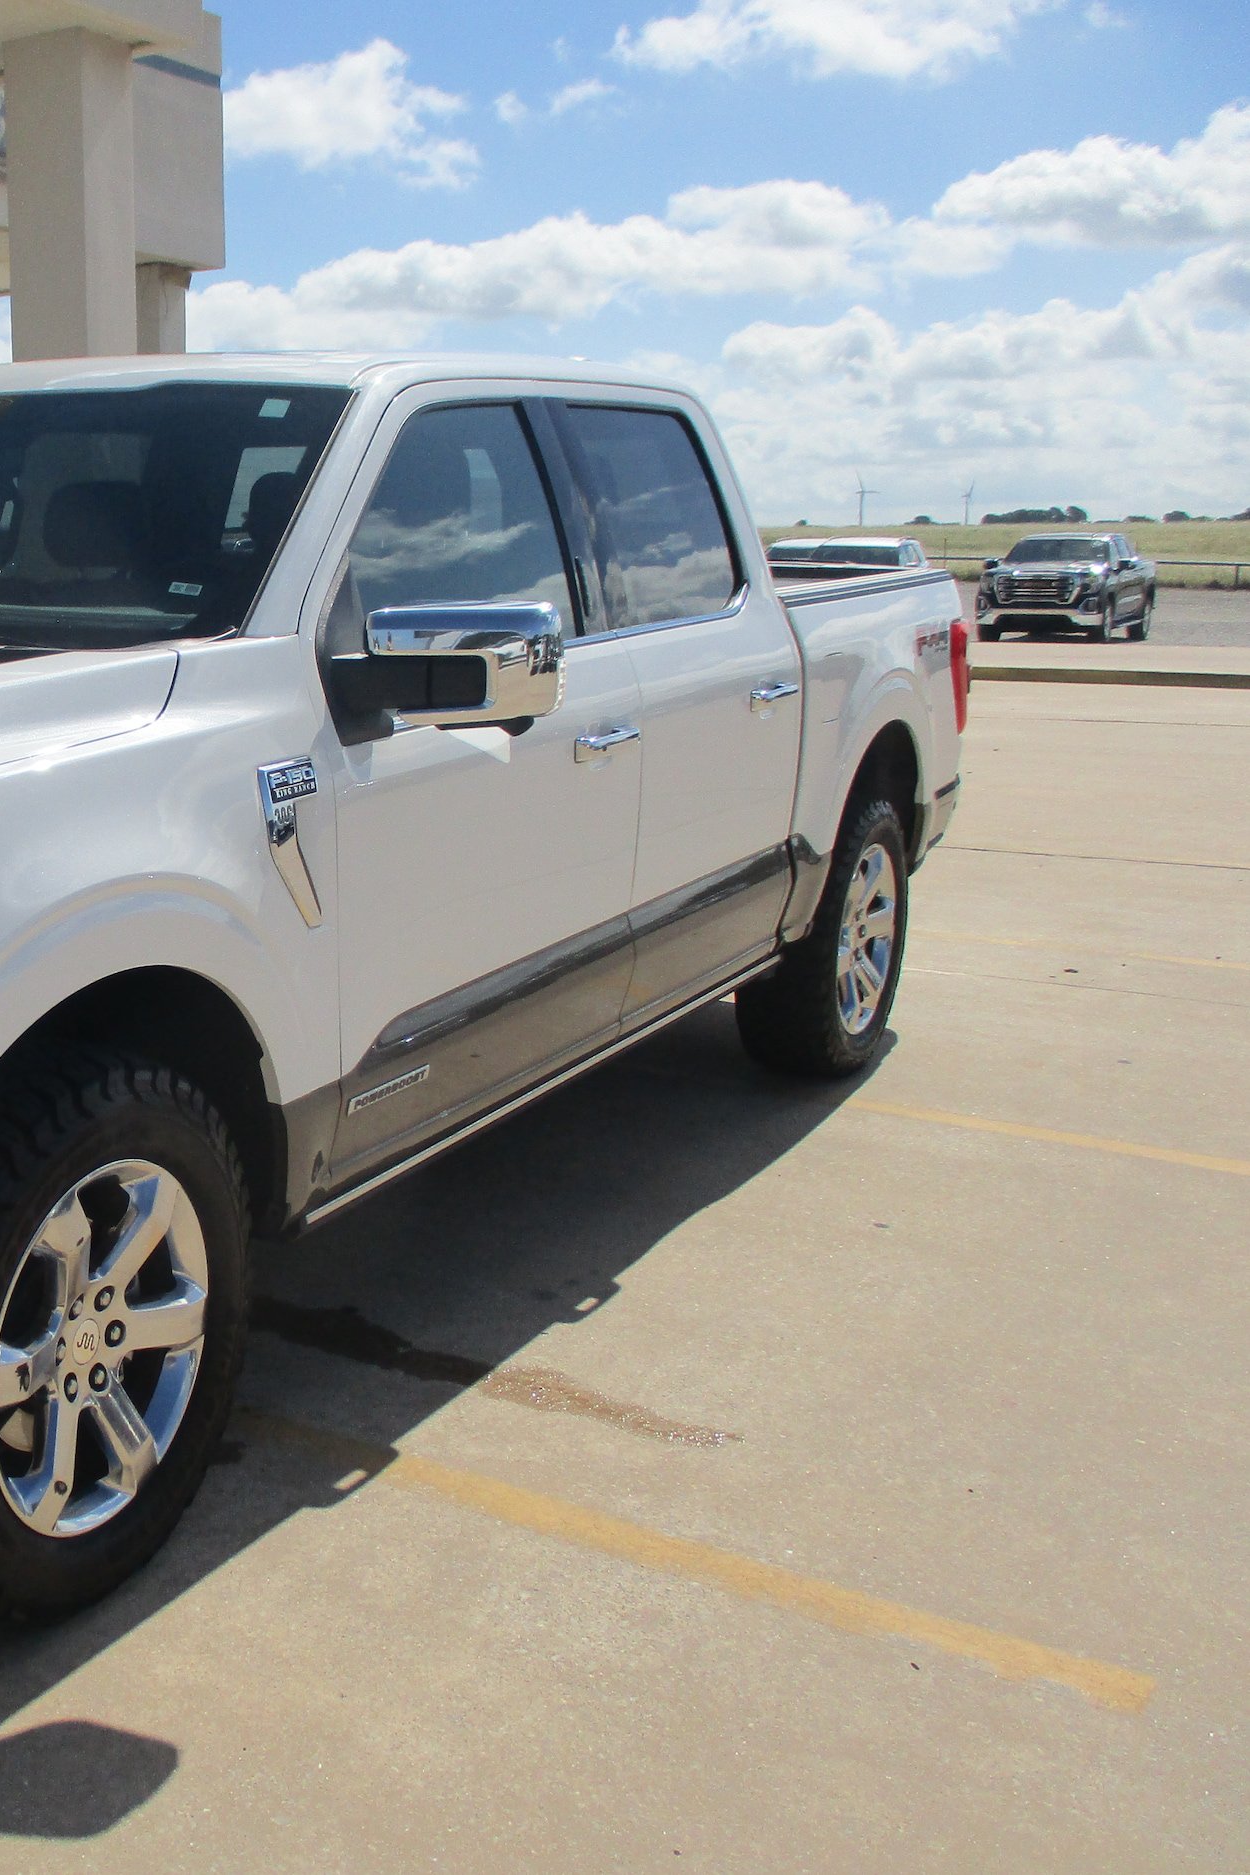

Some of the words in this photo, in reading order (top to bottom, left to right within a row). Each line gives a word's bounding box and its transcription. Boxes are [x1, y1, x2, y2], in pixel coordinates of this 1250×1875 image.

[269, 766, 315, 788] F-150
[275, 787, 292, 799] KING
[294, 781, 315, 793] RANCH
[354, 1069, 426, 1110] POWERBOOST
